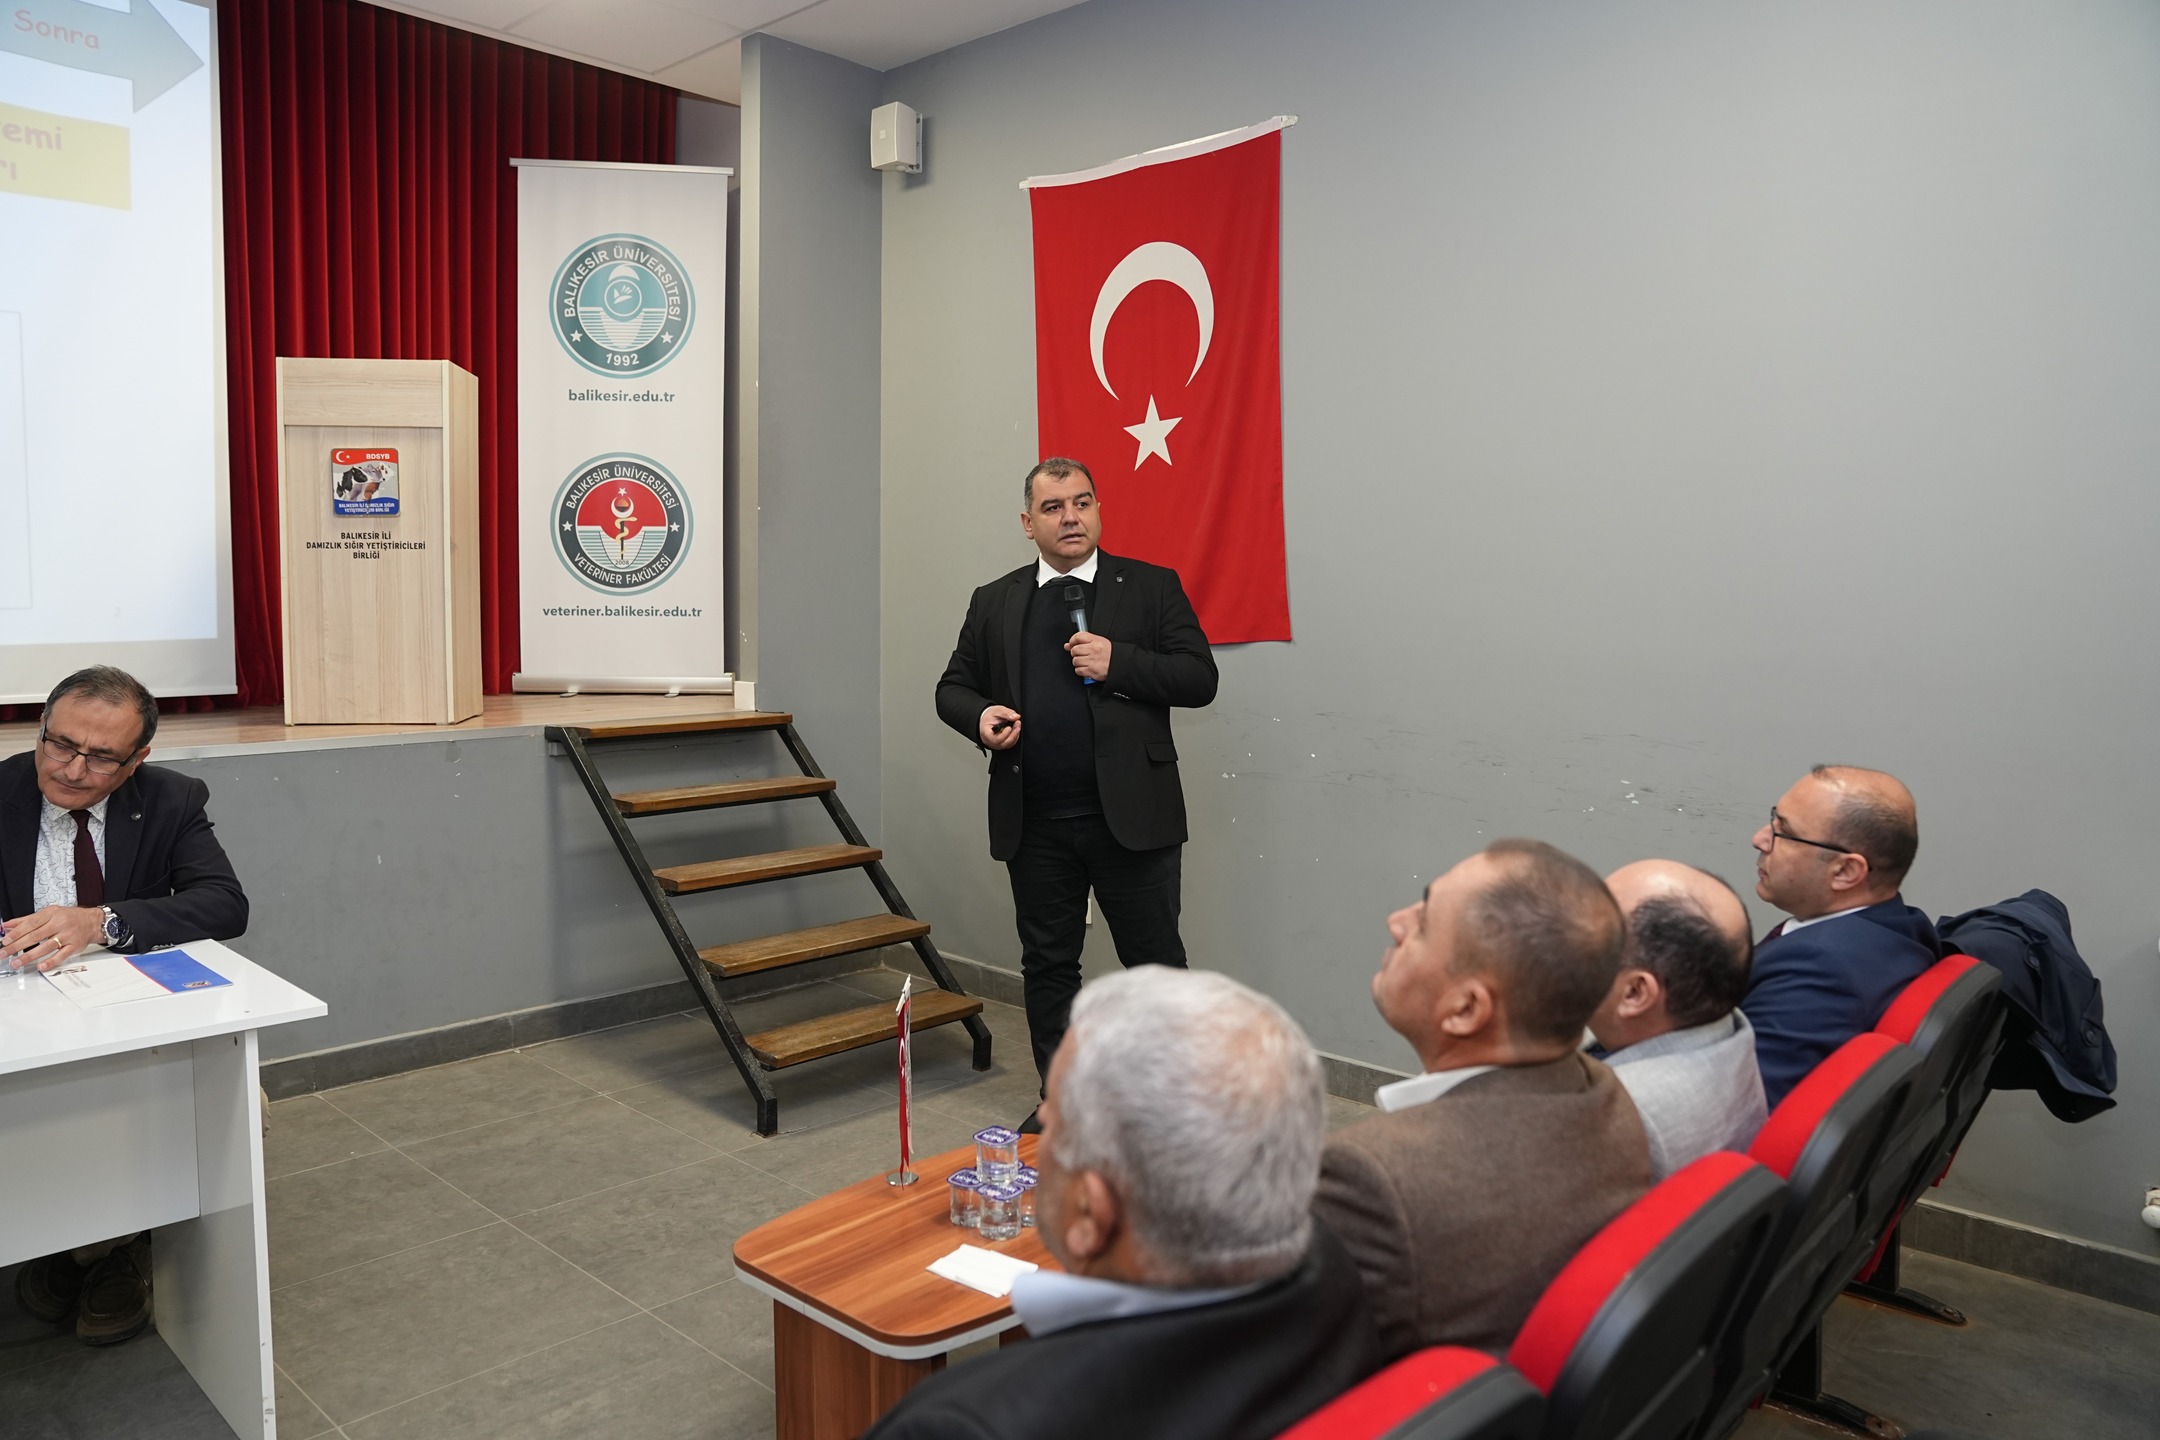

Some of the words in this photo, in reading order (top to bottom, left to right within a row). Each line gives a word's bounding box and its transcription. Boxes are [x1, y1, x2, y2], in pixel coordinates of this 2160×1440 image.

[14, 9, 100, 50] Sonra
[0, 119, 62, 151] emi
[564, 249, 610, 318] BALIKESİR
[613, 245, 682, 322] ÜNİVERSİTESİ
[606, 353, 640, 366] 1992
[568, 389, 675, 402] balikesir.edu.tr
[566, 467, 610, 509] BALIKESİR
[614, 464, 679, 510] ÜNİVERSİTESİ
[341, 532, 379, 540] BALIKESİR
[382, 531, 391, 540] İLİ
[306, 542, 342, 550] DAMIZLIK
[344, 541, 364, 550] SIĞIR
[367, 541, 426, 551] YETİŞTİRİCİLERİ
[353, 551, 380, 560] BİRLİĞİ
[574, 552, 623, 585] VETERİNER
[625, 552, 672, 585] FAKÜLTESİ
[542, 605, 702, 618] veteriner.balikesir.edu.tr
